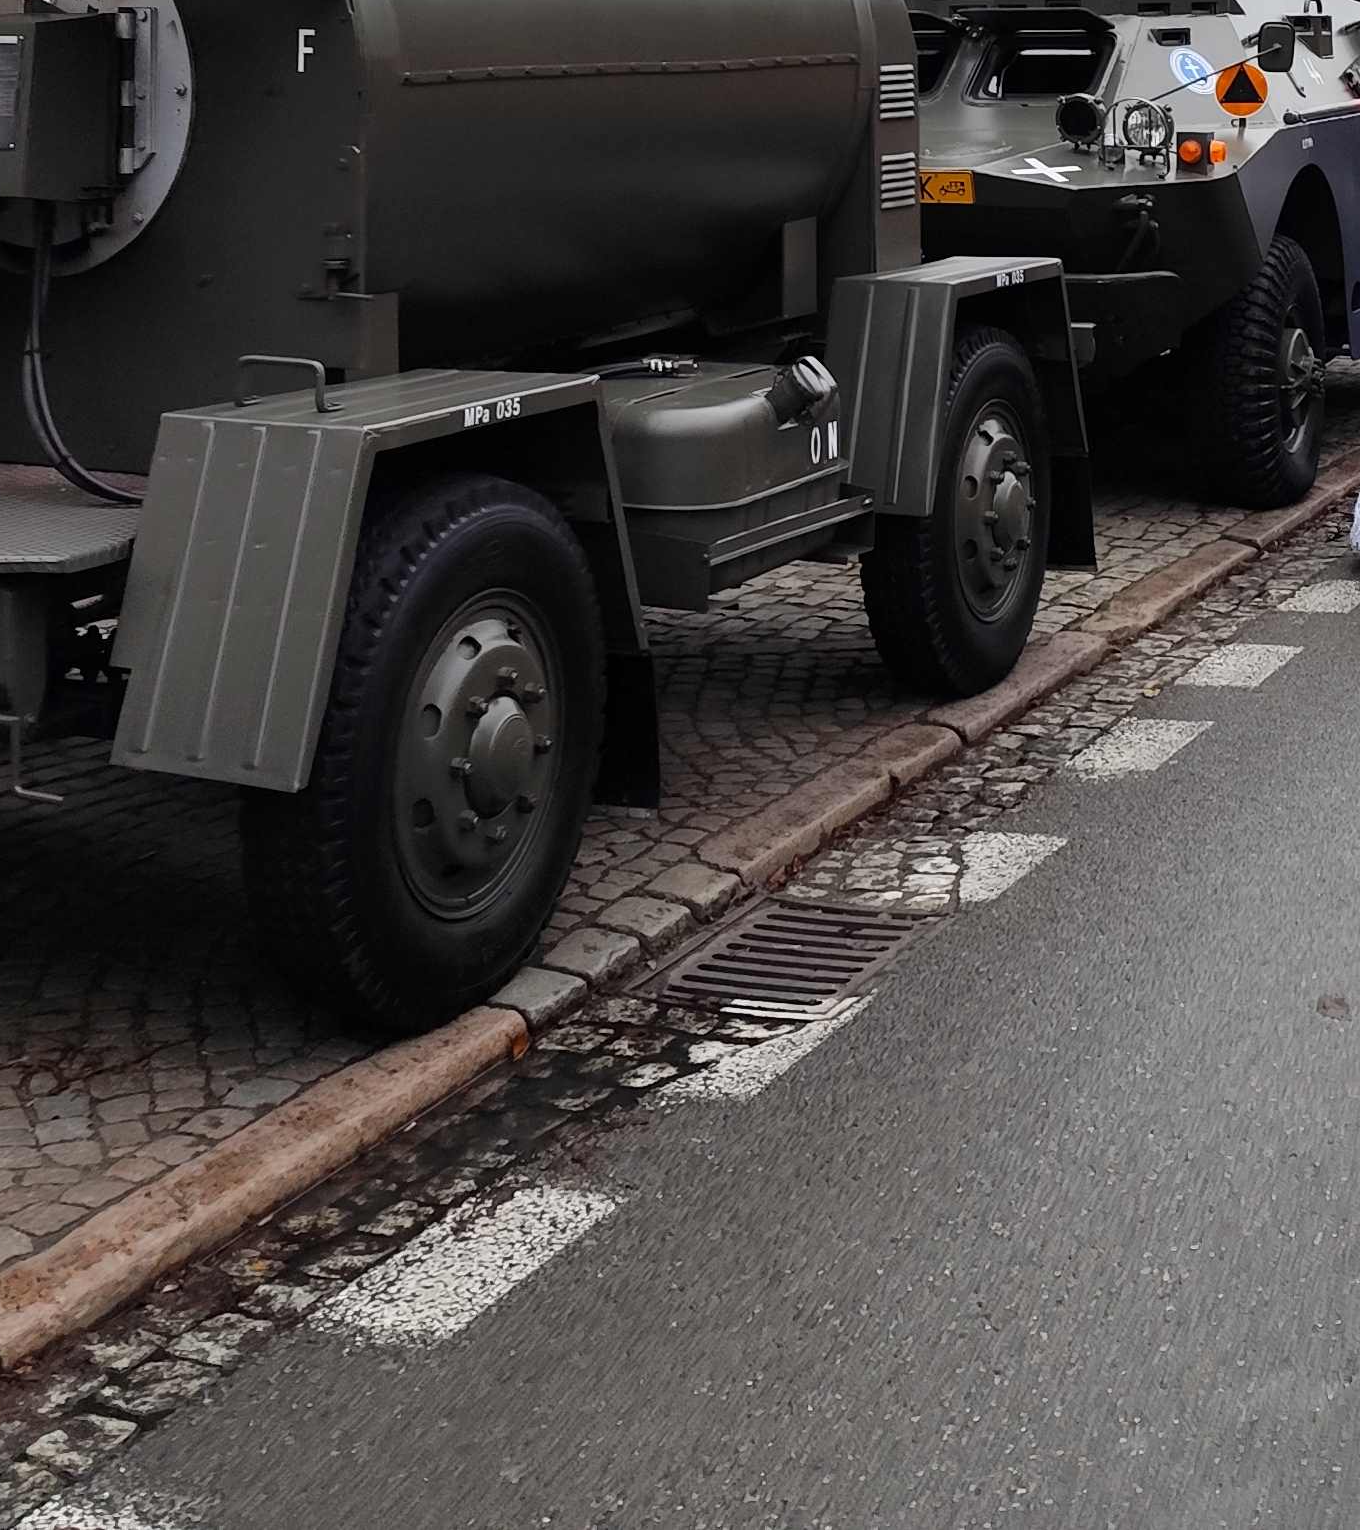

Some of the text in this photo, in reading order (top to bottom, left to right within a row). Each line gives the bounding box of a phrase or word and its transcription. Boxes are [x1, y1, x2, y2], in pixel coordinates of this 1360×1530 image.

[297, 28, 316, 73] F
[463, 396, 521, 428] MPa 035
